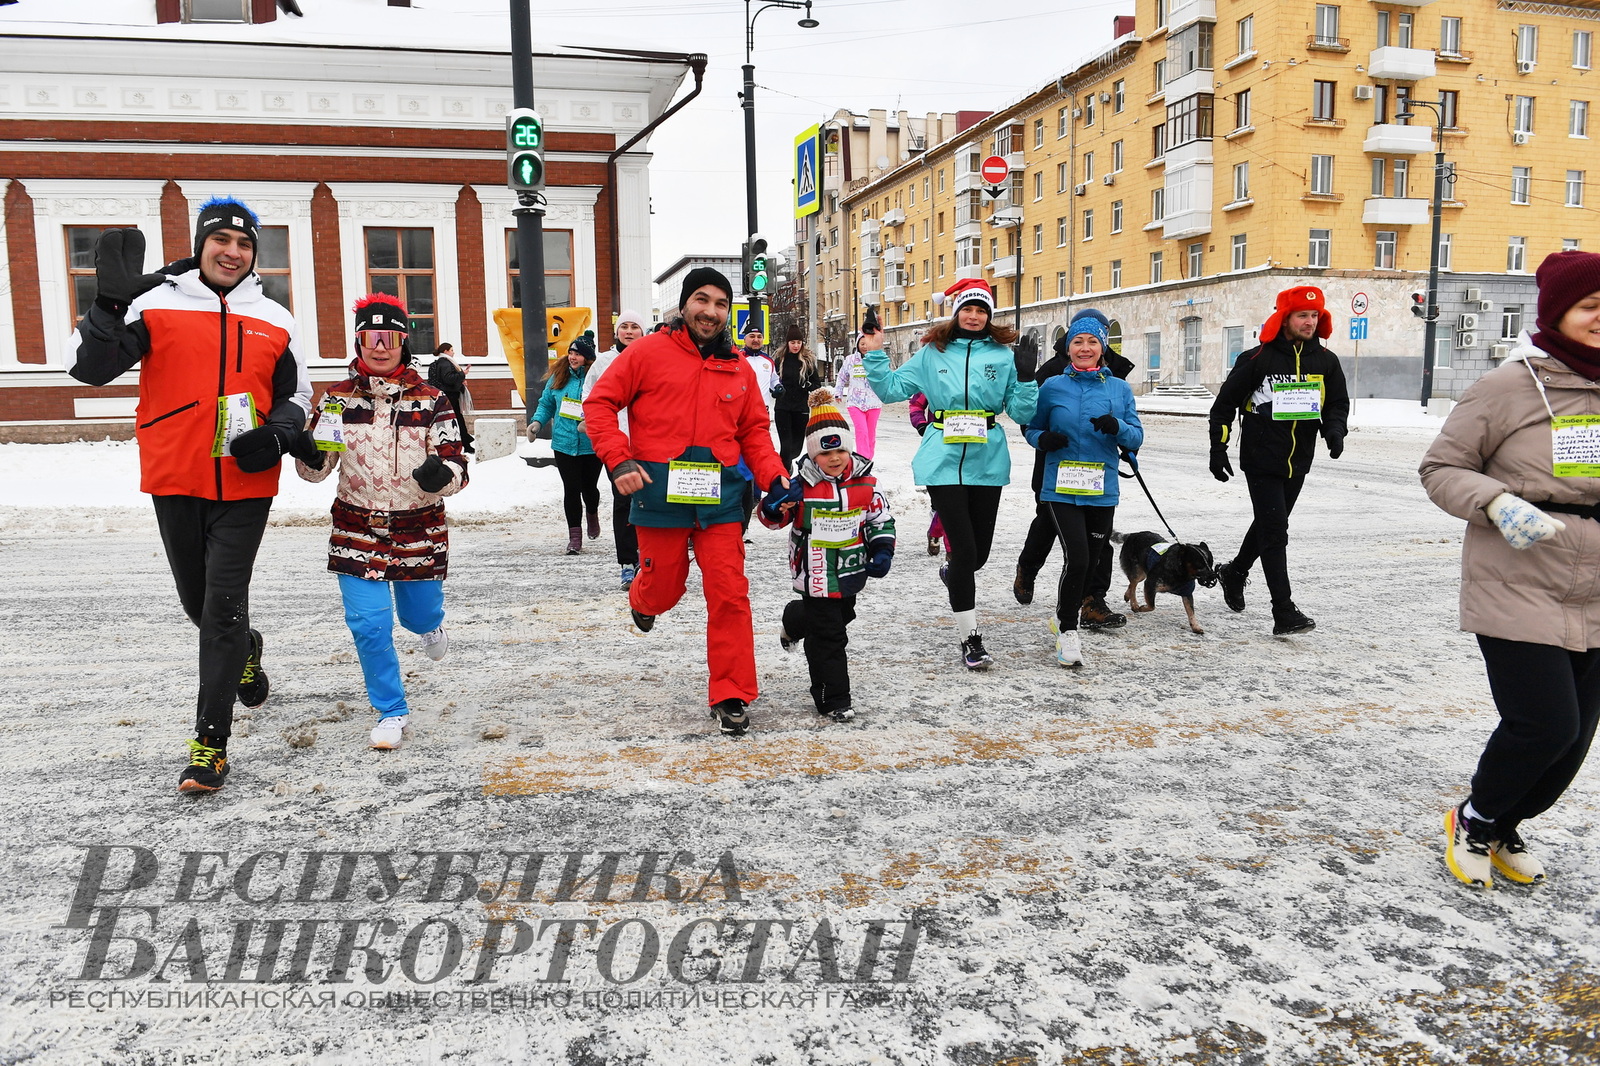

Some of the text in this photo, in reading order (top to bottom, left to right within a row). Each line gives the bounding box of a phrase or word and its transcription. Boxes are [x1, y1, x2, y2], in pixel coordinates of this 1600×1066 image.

[515, 124, 538, 146] 26
[753, 260, 765, 271] 26
[957, 292, 991, 304] SUPERSPORT
